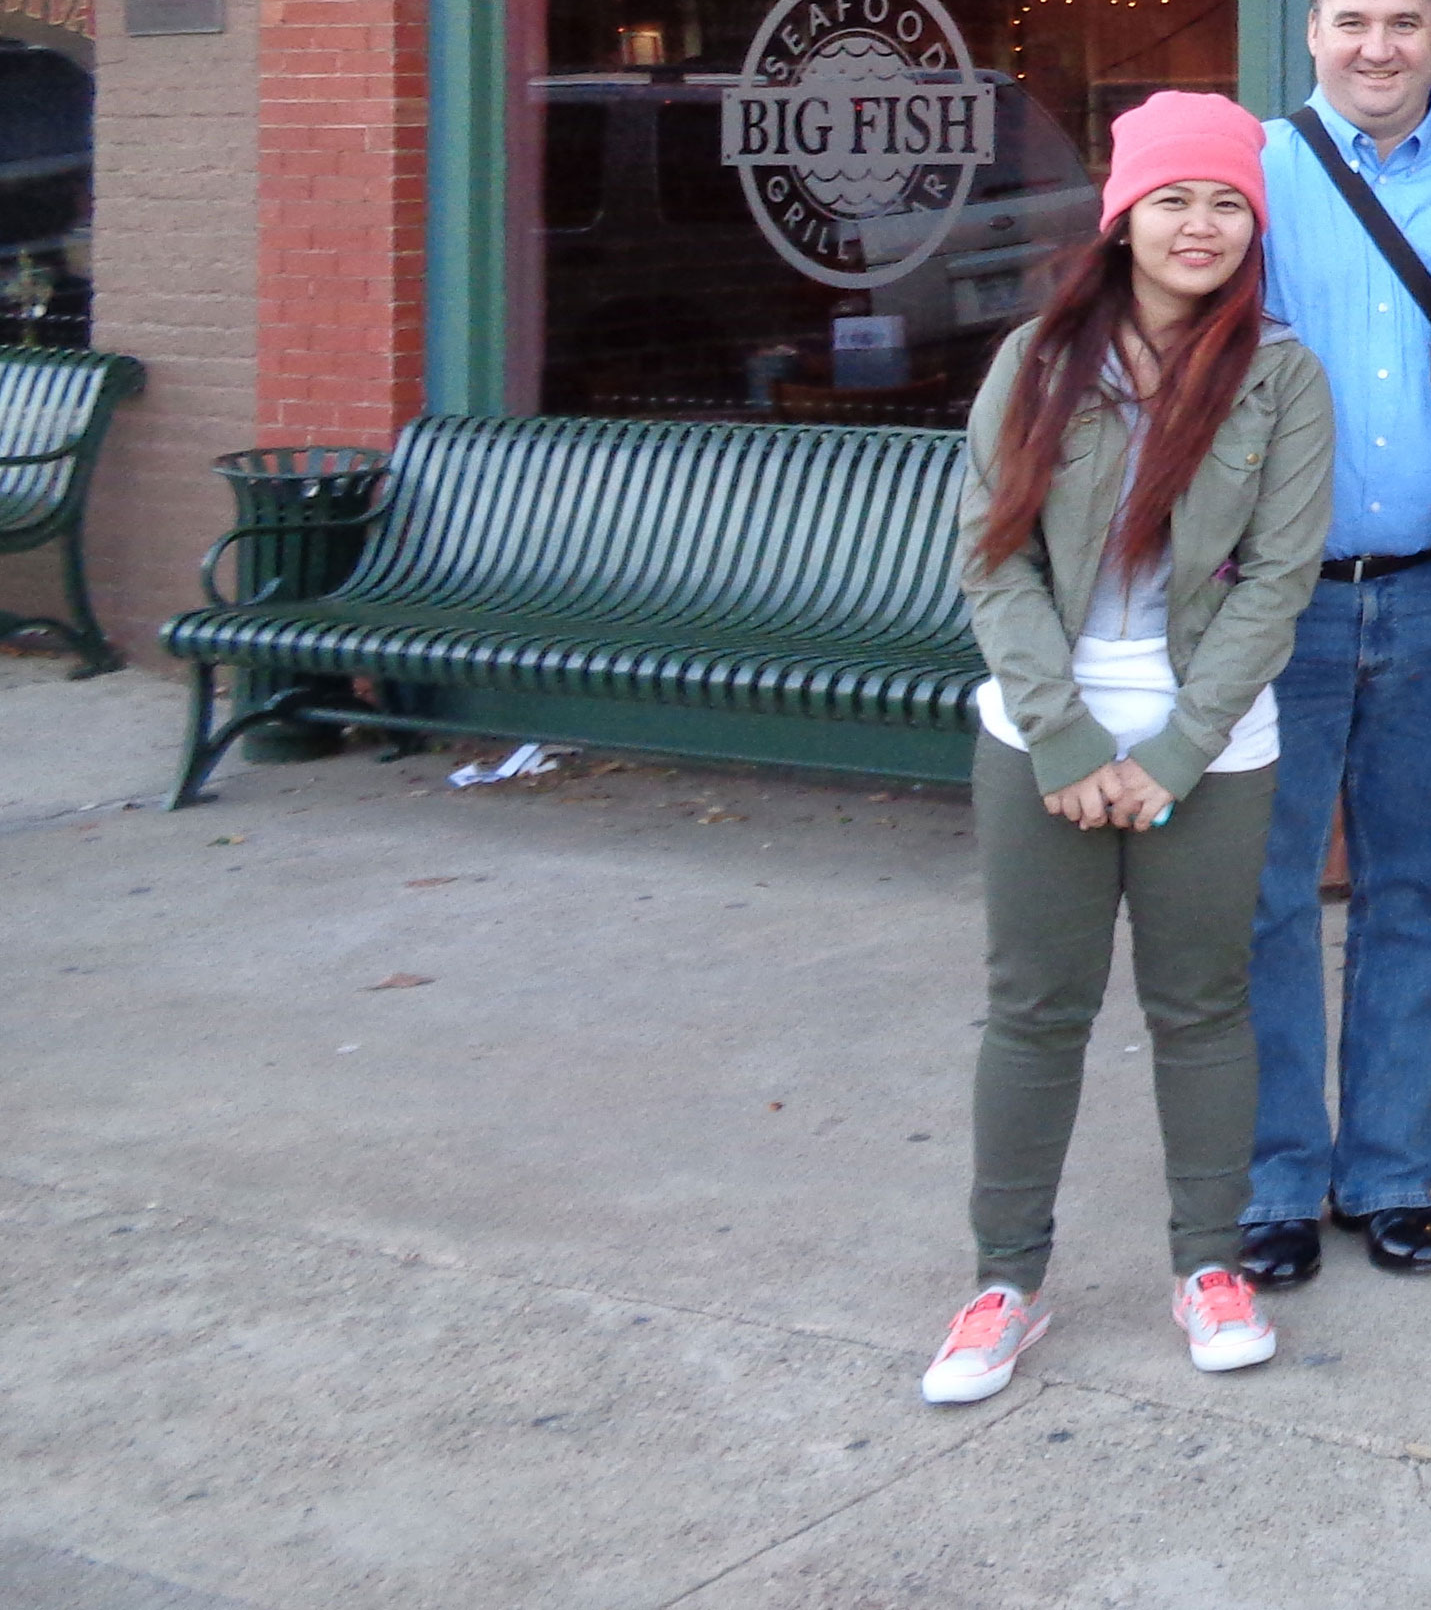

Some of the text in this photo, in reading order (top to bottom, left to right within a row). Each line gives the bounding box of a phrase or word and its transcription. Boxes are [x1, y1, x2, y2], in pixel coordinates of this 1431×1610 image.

[738, 94, 978, 156] BIG FISH
[766, 175, 849, 260] GRILL
